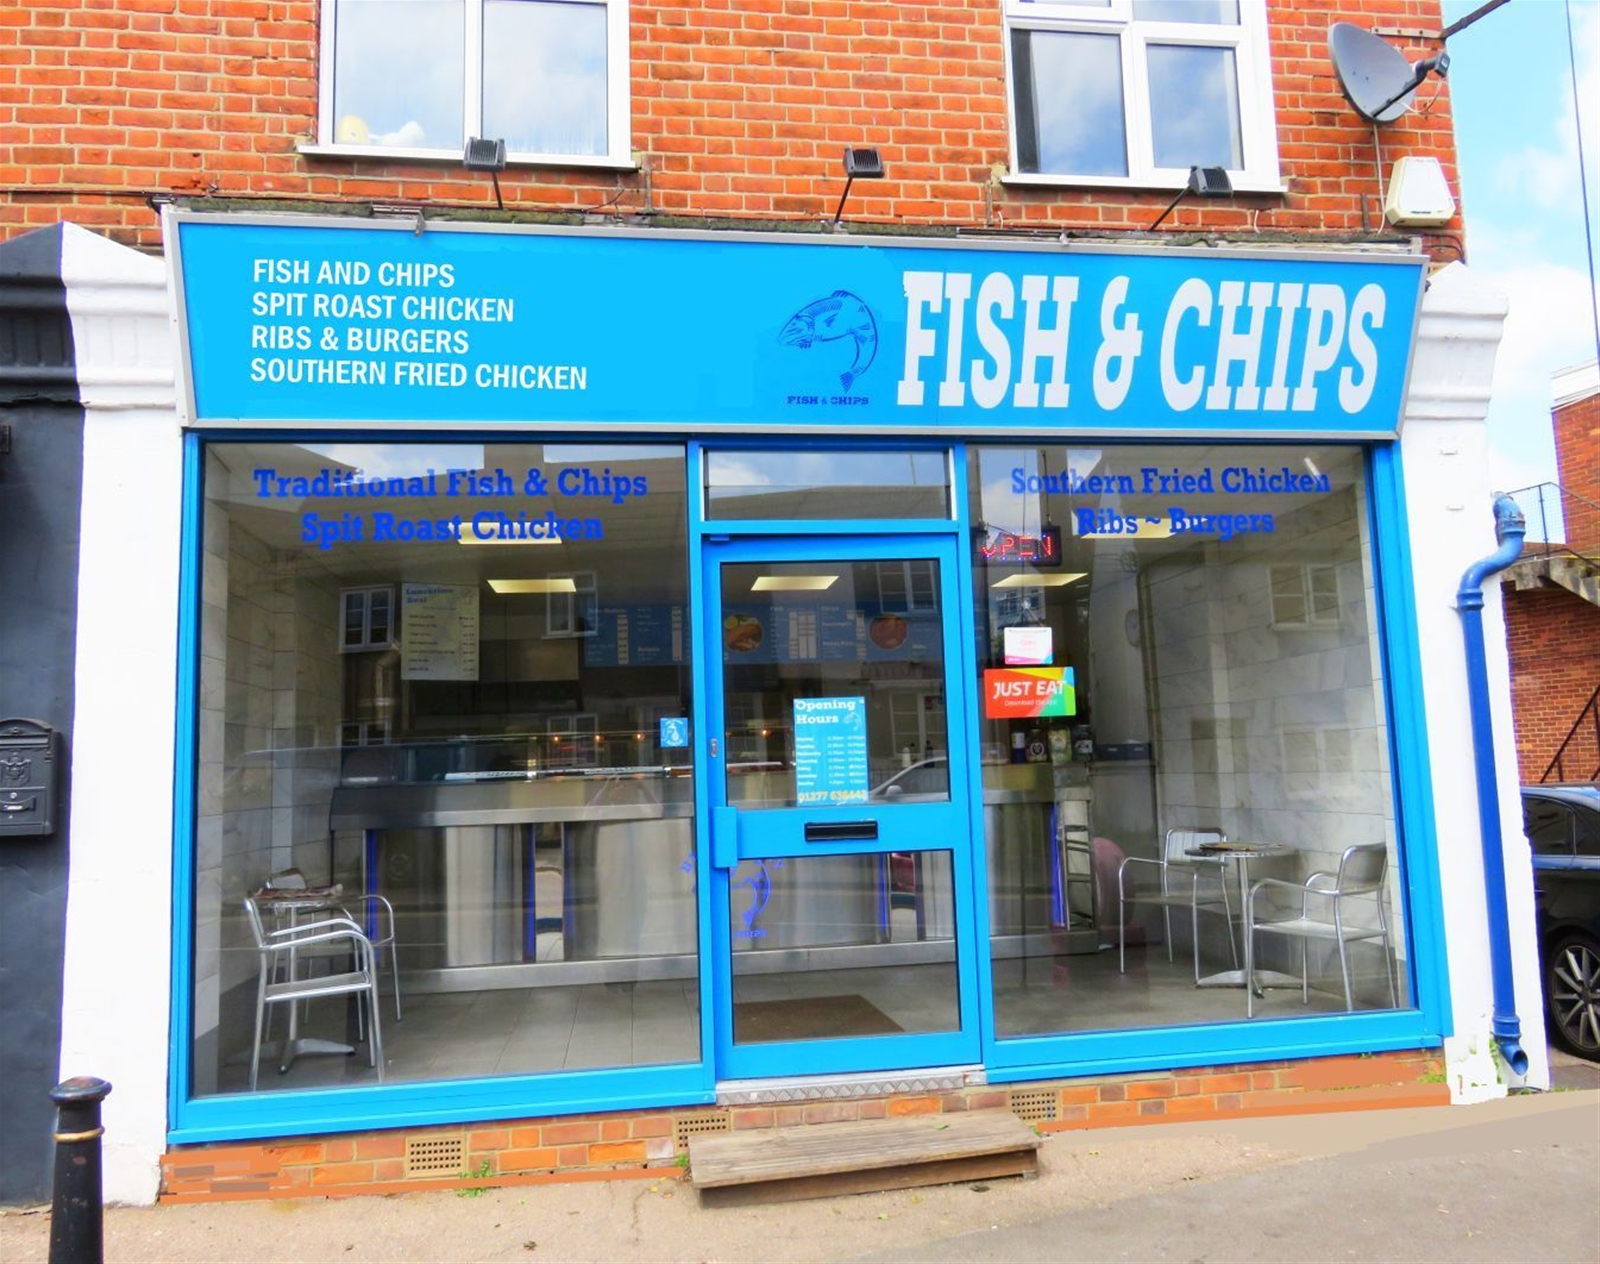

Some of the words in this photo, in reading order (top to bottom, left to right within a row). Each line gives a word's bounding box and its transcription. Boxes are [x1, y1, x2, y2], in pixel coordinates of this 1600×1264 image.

[253, 259, 310, 284] FISH
[316, 260, 371, 286] AND
[378, 262, 455, 288] CHIPS
[252, 291, 308, 317] SPIT
[313, 293, 397, 319] ROAST
[402, 296, 514, 323] CHICKEN
[251, 325, 312, 350] RIBS
[320, 326, 339, 351] &
[347, 327, 469, 354] BURGERS
[897, 271, 1080, 409] FISH
[1092, 275, 1143, 411] &
[1160, 278, 1386, 414] CHIPS
[250, 357, 386, 385] SOUTHERN
[394, 361, 468, 387] FRIED
[475, 363, 587, 390] CHICKEN
[787, 396, 819, 405] FISH
[830, 396, 870, 405] CHIPS
[253, 468, 438, 498] Traditional
[446, 468, 515, 497] Fish
[523, 467, 549, 497] &
[557, 467, 648, 504] Chips
[1011, 467, 1135, 494] Southern
[1140, 467, 1215, 494] Fried
[1220, 467, 1332, 493] Chicken
[302, 511, 364, 550] Spit
[372, 511, 462, 541] Roast
[472, 510, 605, 540] Chicken
[1076, 506, 1138, 535] Ribs
[1167, 506, 1274, 542] Burgers
[992, 681, 1032, 699] JUST
[1035, 680, 1066, 696] EAT
[795, 699, 856, 712] Opening
[796, 714, 840, 725] Hours
